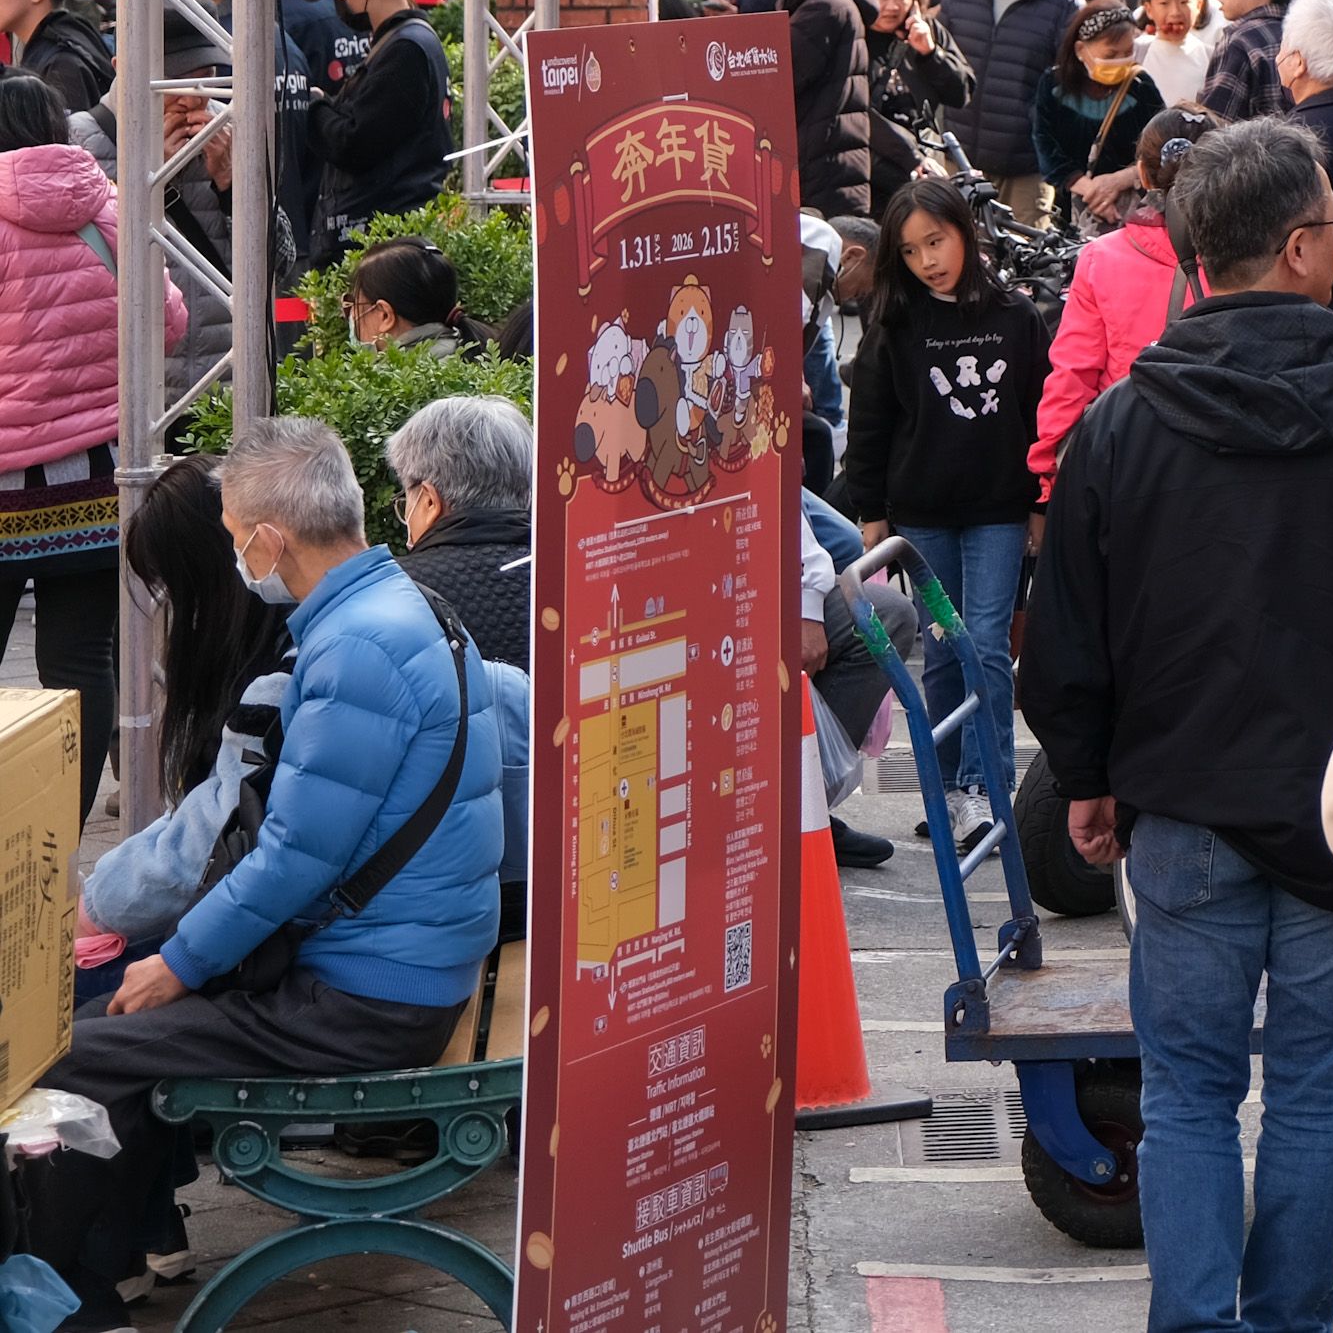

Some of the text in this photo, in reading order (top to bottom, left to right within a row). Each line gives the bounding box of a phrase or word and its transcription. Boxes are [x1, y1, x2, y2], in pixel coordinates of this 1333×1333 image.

[541, 59, 579, 95] taipei
[611, 117, 736, 204] 奔年貨
[619, 222, 740, 270] 1.31 SAT 2026 2.15 SUN
[649, 1027, 705, 1075] 交通資訊
[645, 1065, 707, 1101] Traffic Information
[636, 1172, 707, 1231] 接駁車資訊
[621, 1234, 653, 1259] Shuttle
[653, 1227, 669, 1245] Bus
